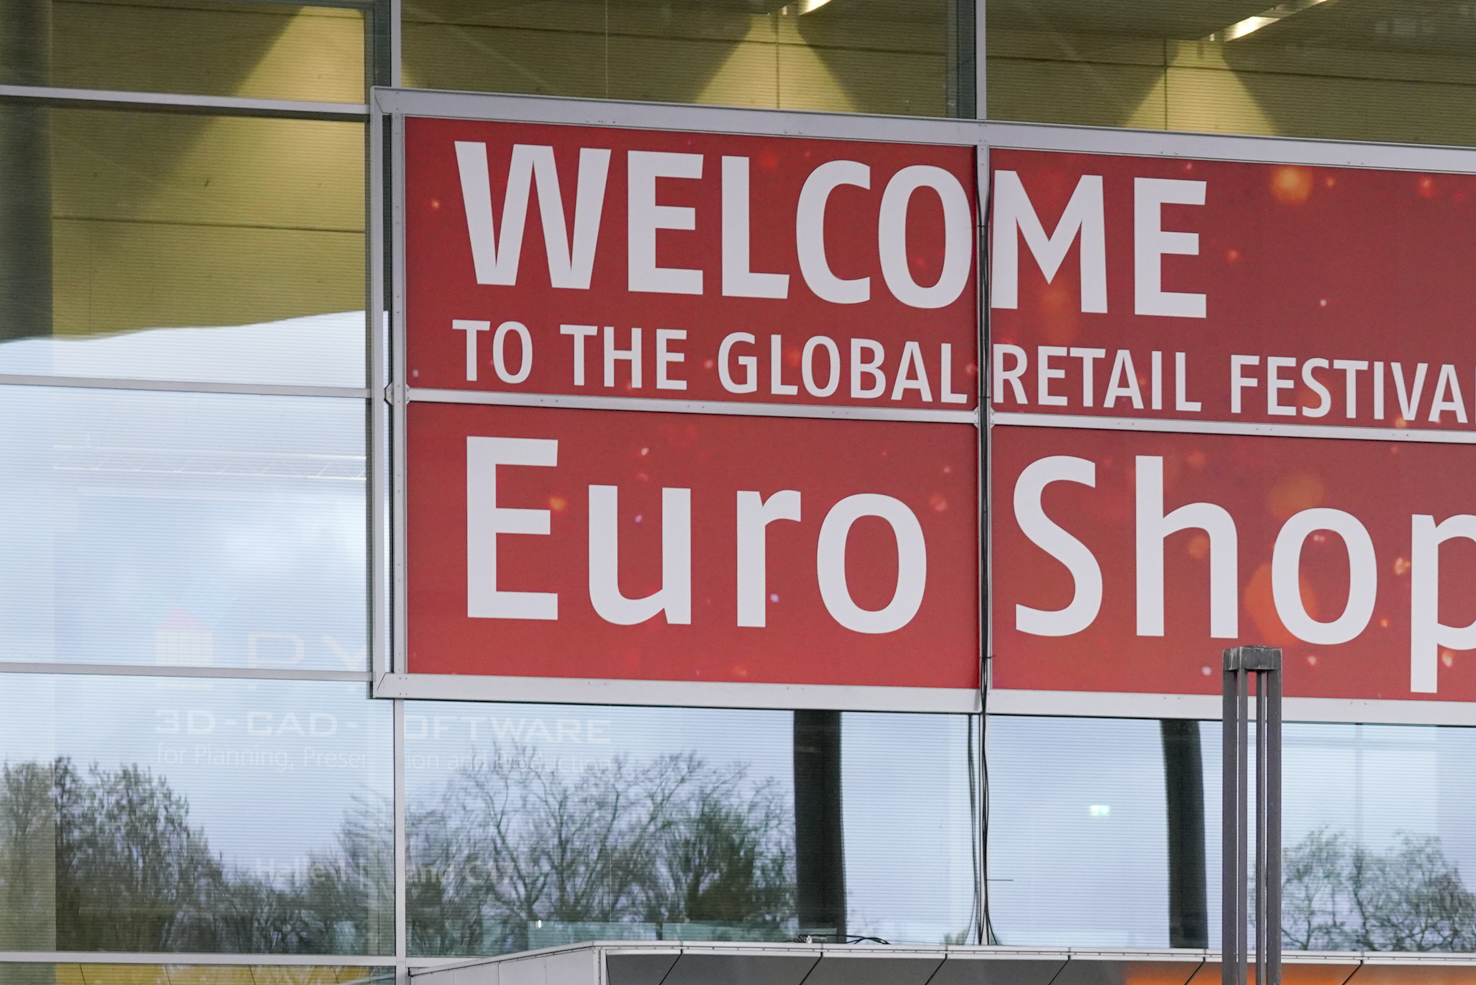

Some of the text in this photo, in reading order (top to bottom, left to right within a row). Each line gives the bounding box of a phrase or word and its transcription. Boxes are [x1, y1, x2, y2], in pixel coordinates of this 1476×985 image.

[454, 140, 1207, 319] WELCOME
[452, 319, 533, 384] TO
[560, 324, 688, 391] THE
[717, 331, 968, 404] GLOBAL
[992, 343, 1202, 412] RETAIL
[466, 435, 927, 635] Euro
[157, 742, 184, 765] for
